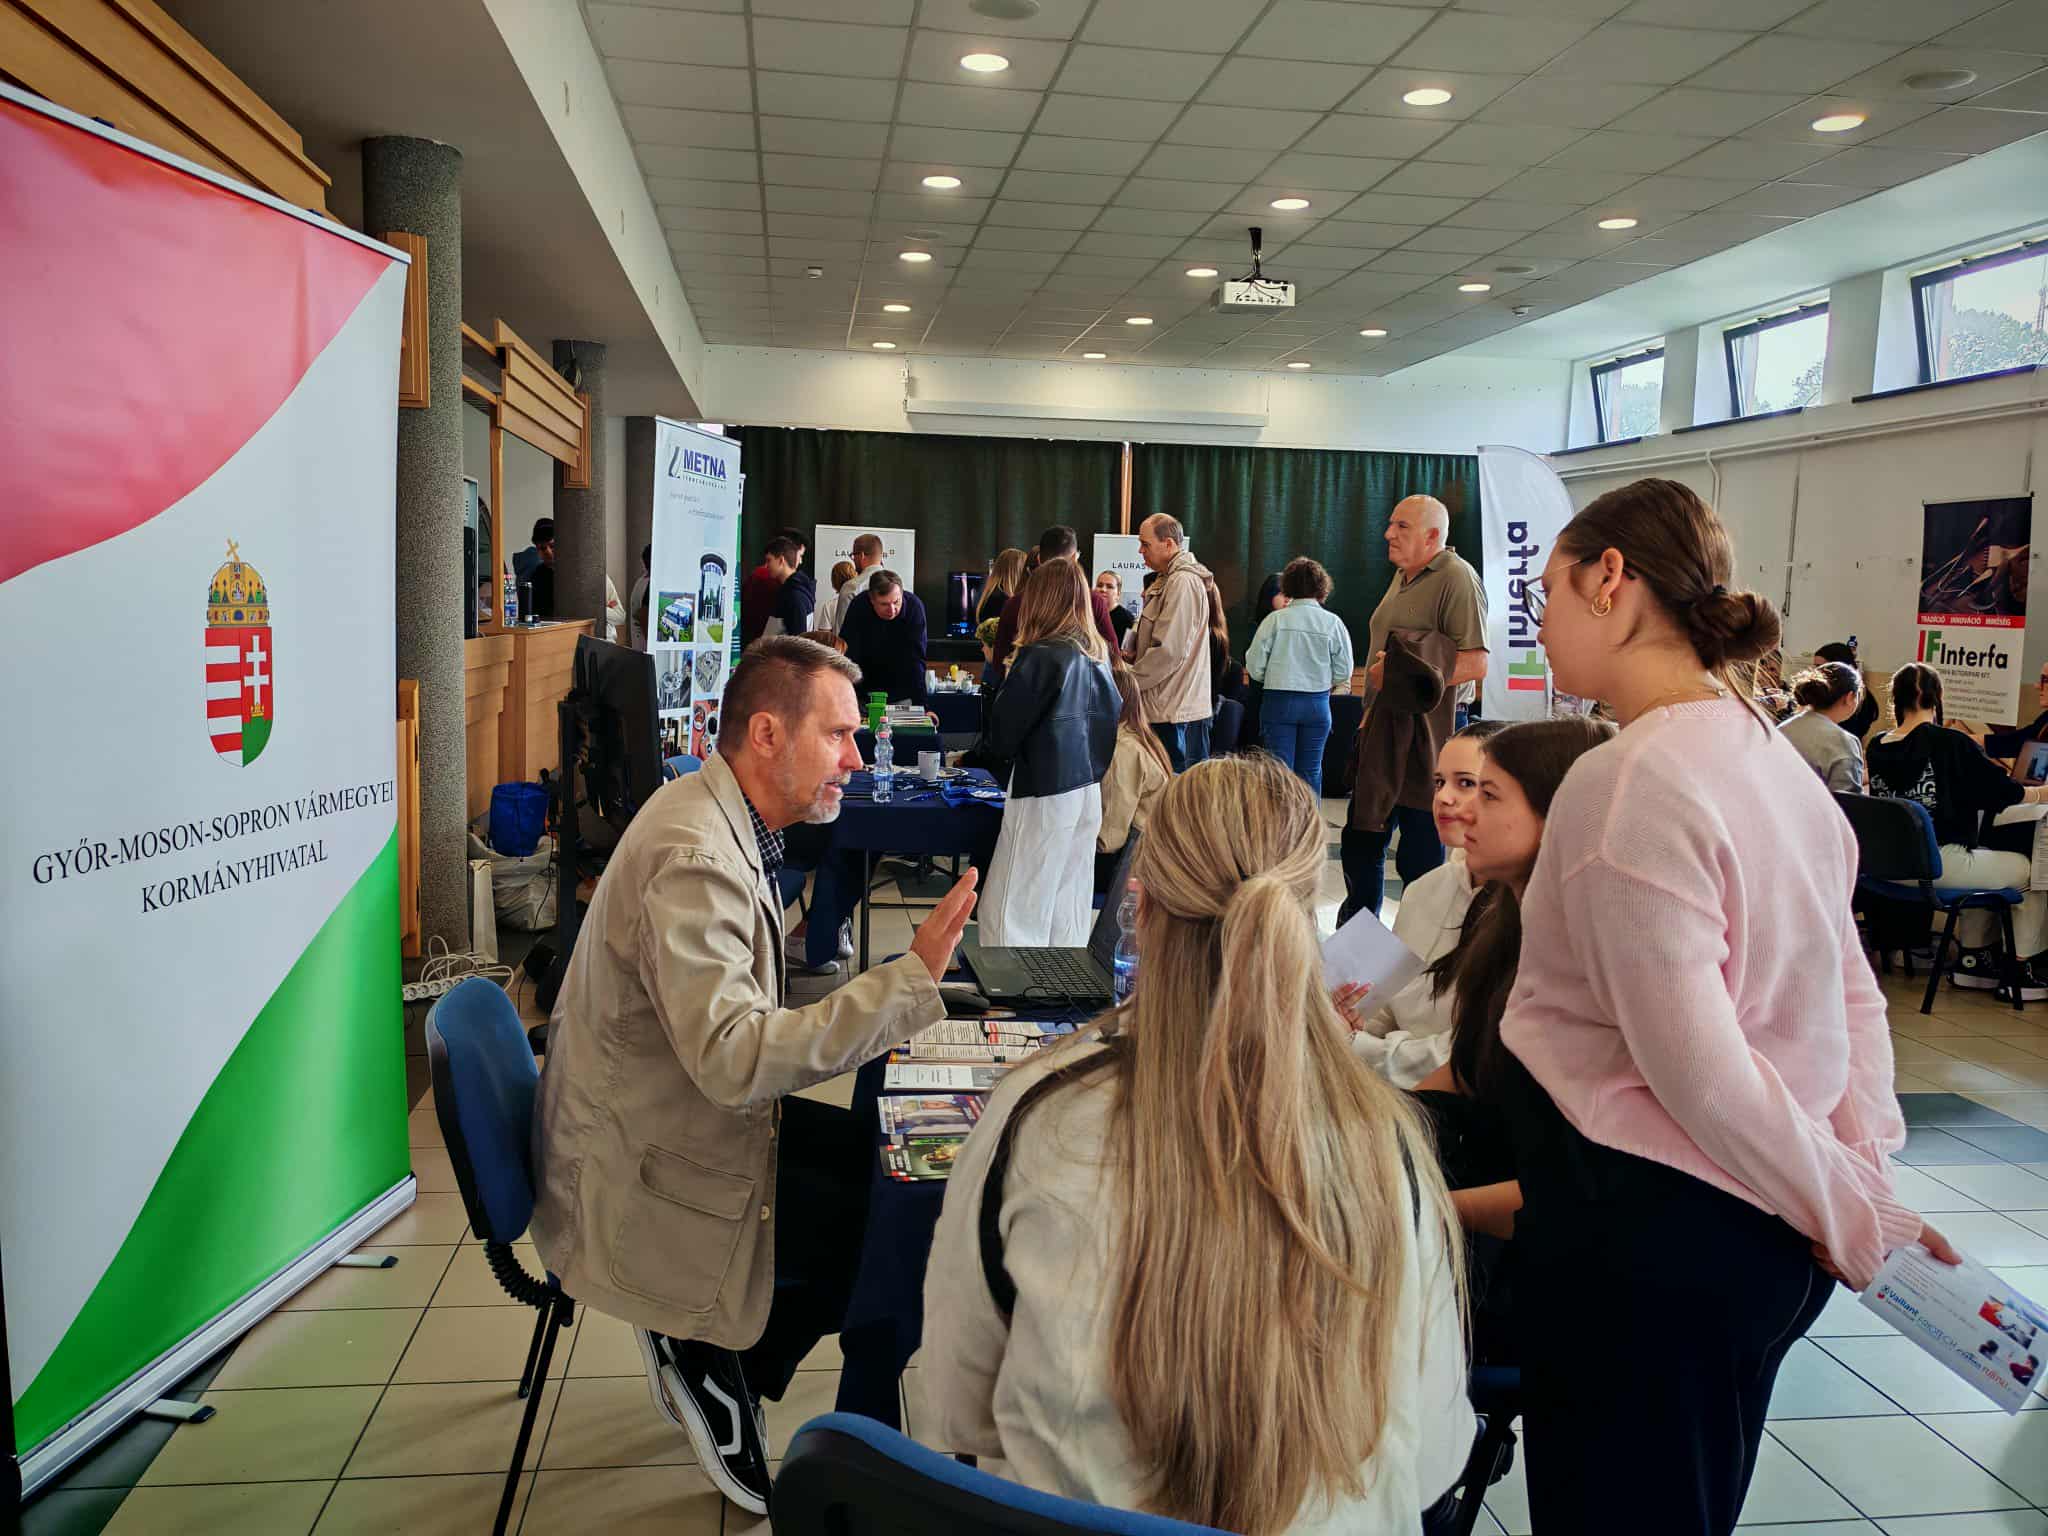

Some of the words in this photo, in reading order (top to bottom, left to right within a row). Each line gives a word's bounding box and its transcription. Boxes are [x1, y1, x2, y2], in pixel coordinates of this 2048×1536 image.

[684, 449, 726, 479] METNA
[1940, 643, 2009, 669] Interfa
[33, 803, 291, 884] GYŐR-MOSON-SOPRON
[294, 780, 394, 825] VÁRMEGYEI
[141, 839, 329, 913] KORMÁNYHIVATAL
